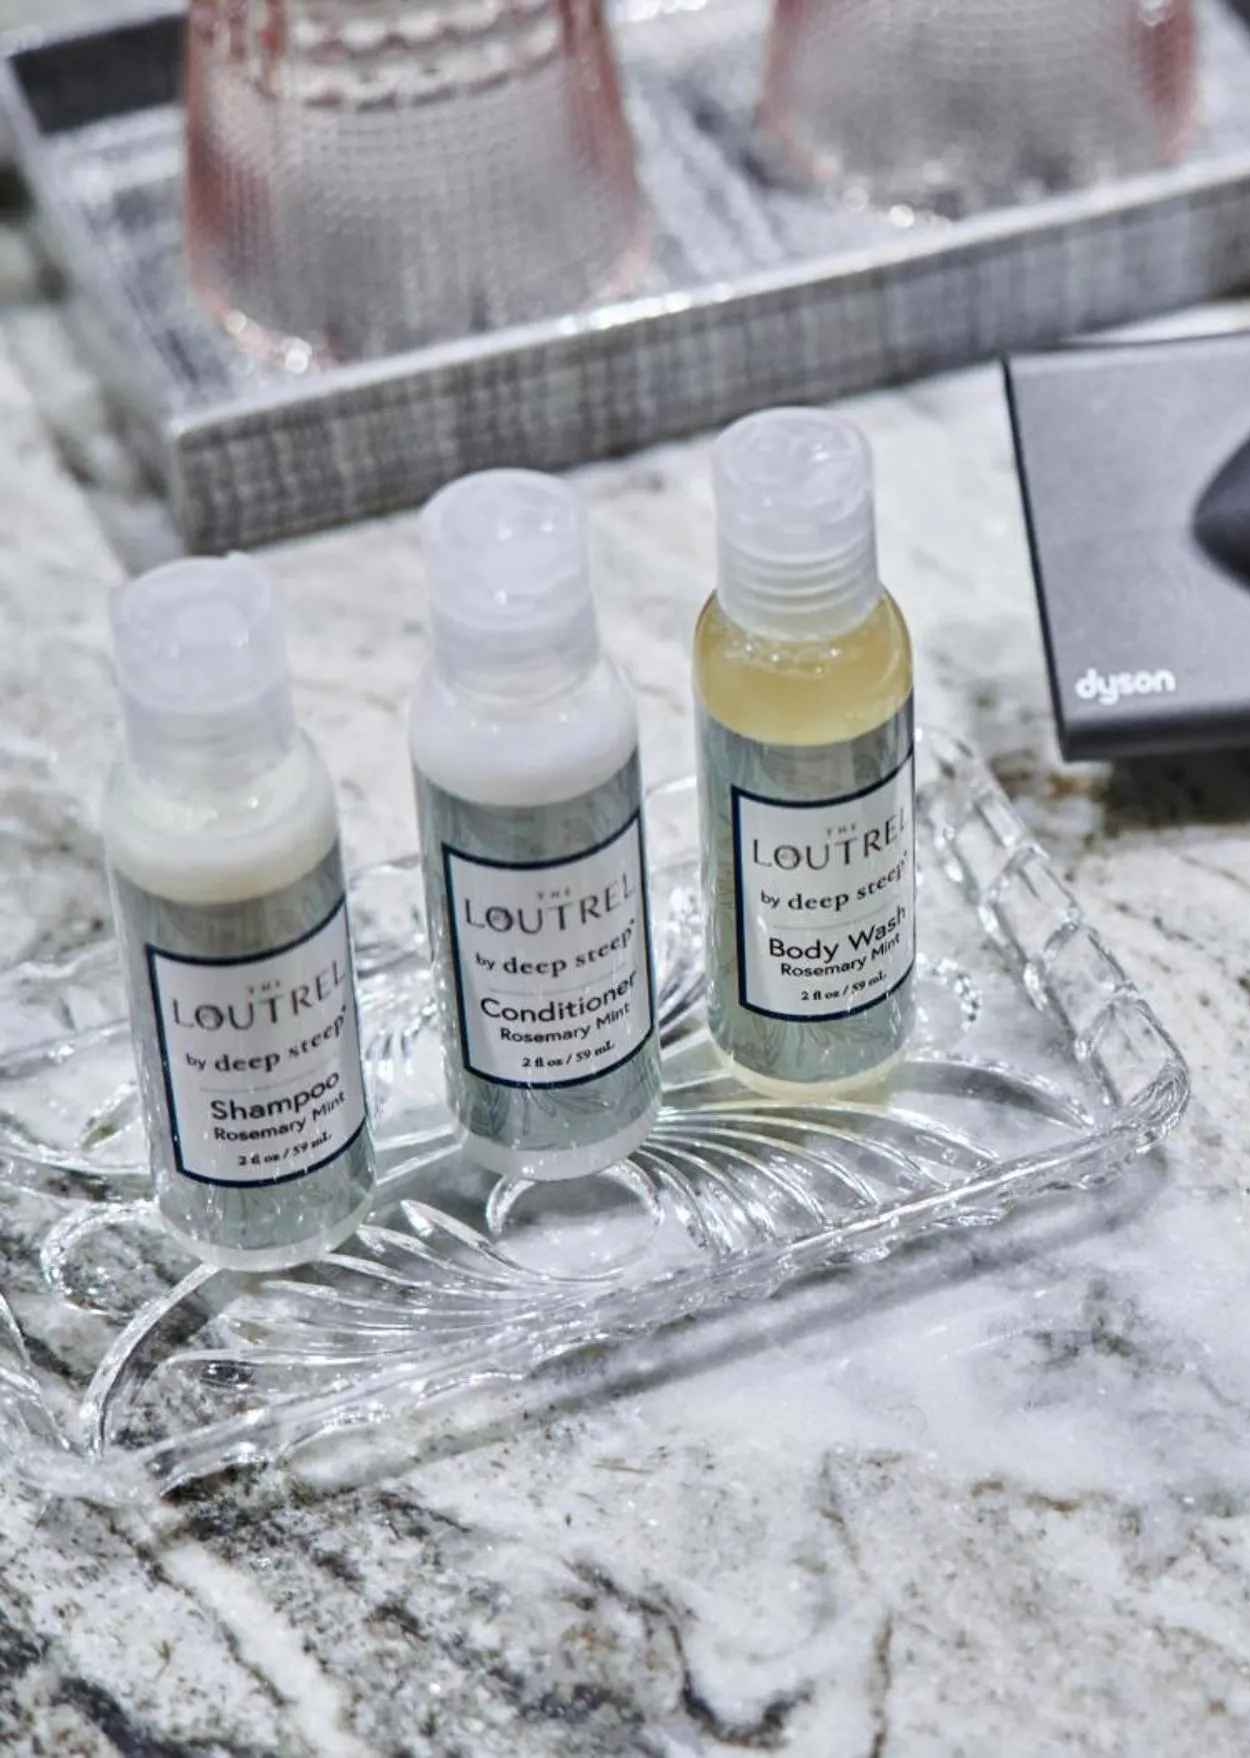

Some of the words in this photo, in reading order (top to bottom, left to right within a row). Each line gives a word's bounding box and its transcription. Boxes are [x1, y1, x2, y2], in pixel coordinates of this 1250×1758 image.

[1075, 668, 1176, 705] dyson
[752, 807, 906, 871] LOUTREL
[464, 872, 637, 935] LOUTREL
[760, 889, 780, 908] by
[788, 893, 850, 911] deep
[768, 937, 840, 964] Body
[848, 905, 906, 951] Wash
[780, 955, 868, 978] Rosemary
[871, 933, 901, 961] Mint
[475, 952, 496, 971] by
[503, 956, 567, 978] deep
[172, 960, 347, 1031] LOUTREL
[480, 969, 637, 1024] Conditioner
[801, 990, 809, 1001] 2
[812, 989, 822, 1001] fl
[825, 990, 840, 1000] oz
[852, 979, 866, 995] 59
[500, 1023, 592, 1046] Rosemary
[595, 1001, 631, 1030] Mint
[185, 1052, 207, 1072] by
[214, 1053, 281, 1072] deep
[522, 1057, 531, 1068] 2
[534, 1056, 544, 1068] fl
[576, 1047, 592, 1062] 59
[210, 1071, 340, 1121] Shampoo
[214, 1115, 306, 1143] Rosemary
[311, 1090, 347, 1121] Mint
[237, 1154, 247, 1167] 2
